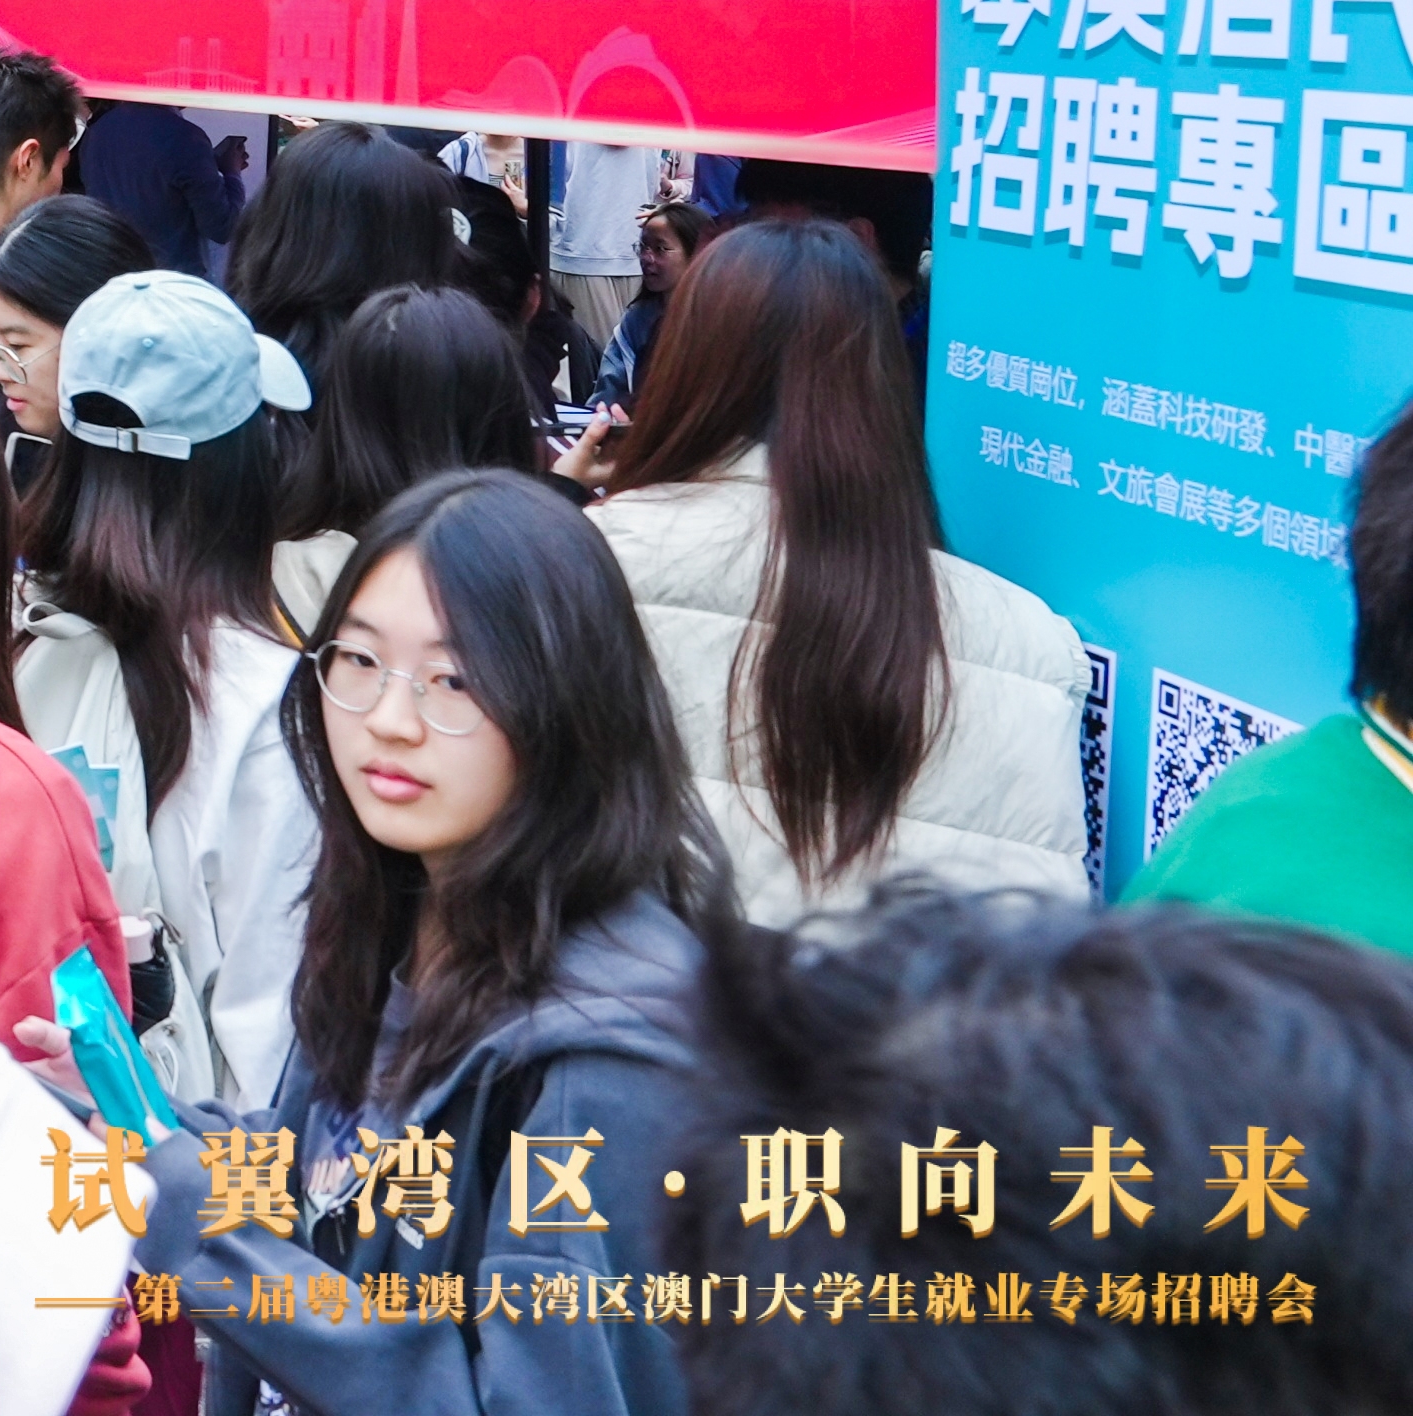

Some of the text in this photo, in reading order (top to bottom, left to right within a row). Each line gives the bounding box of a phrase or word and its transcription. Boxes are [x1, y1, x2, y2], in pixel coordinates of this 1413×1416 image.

[949, 66, 1413, 296] 招聘專區
[946, 340, 1371, 479] 超多優質崗位，涵蓋科技研發、中醫
